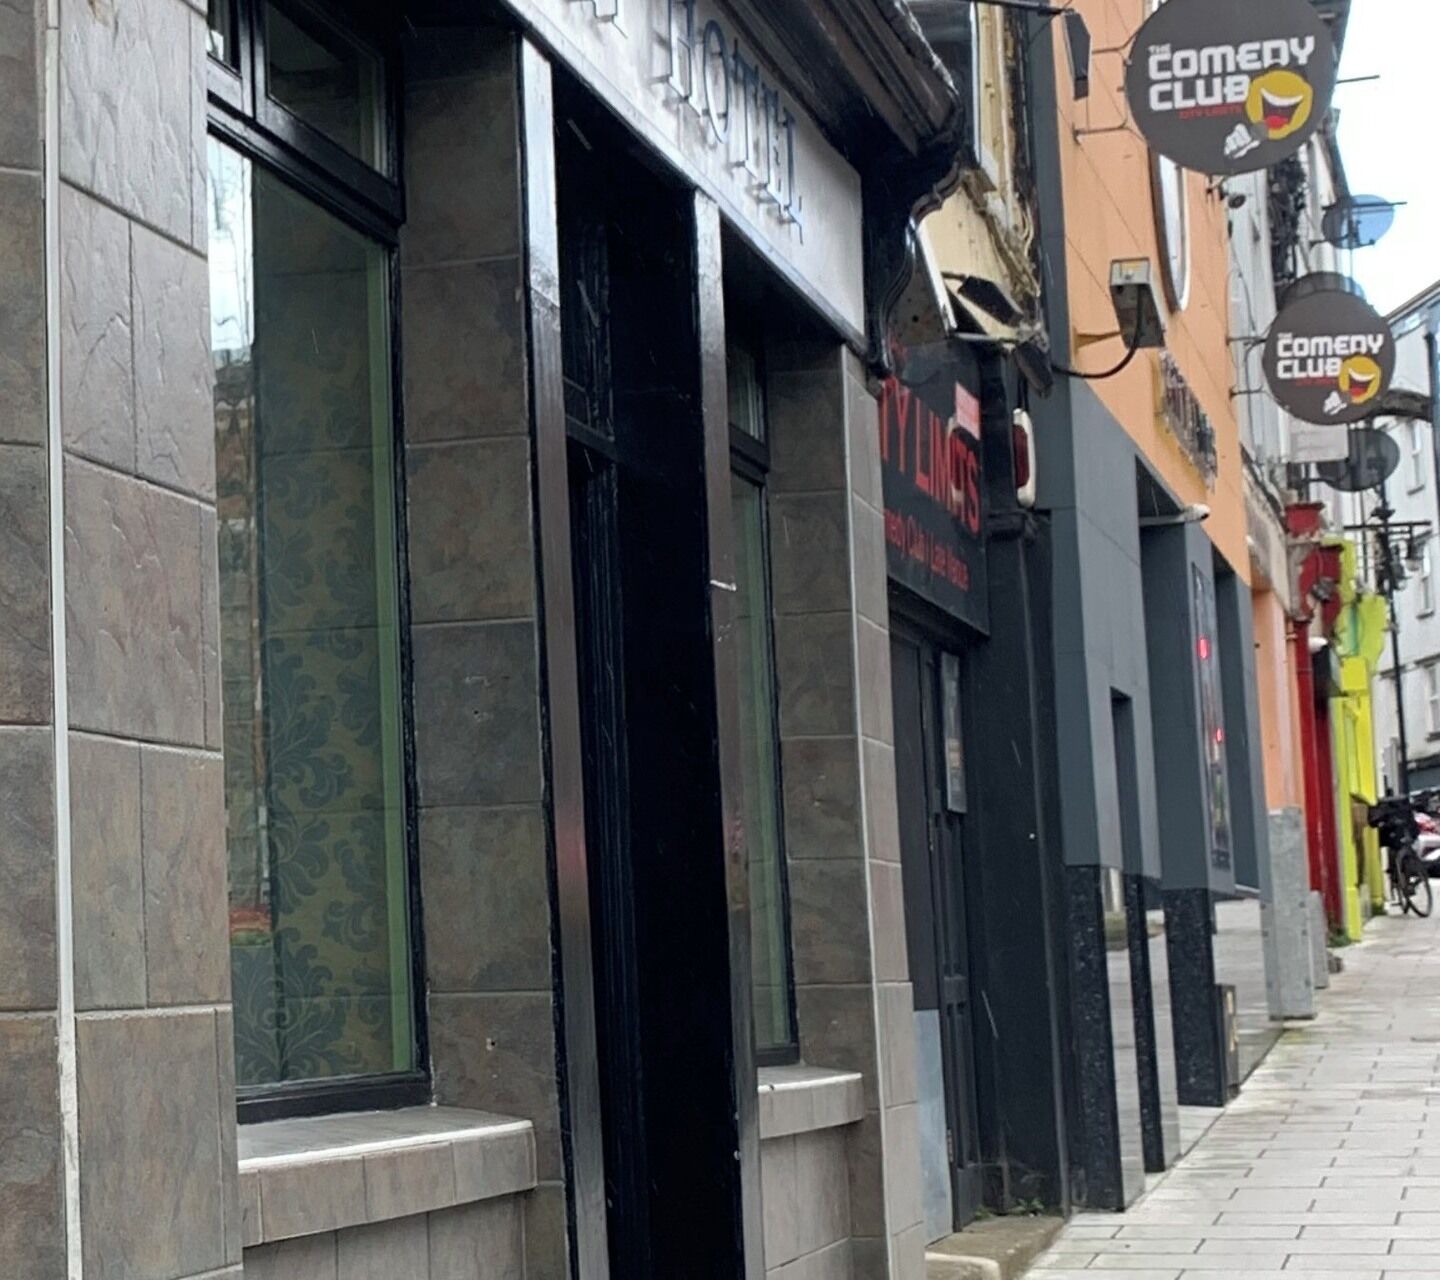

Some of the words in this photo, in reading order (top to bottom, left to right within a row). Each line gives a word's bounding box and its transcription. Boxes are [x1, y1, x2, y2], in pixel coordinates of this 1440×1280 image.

[1148, 36, 1315, 81] COMEDY
[1149, 74, 1251, 112] CLUB
[1277, 333, 1384, 358] COMEDY
[1277, 357, 1341, 379] CLUB
[879, 375, 910, 472] TY
